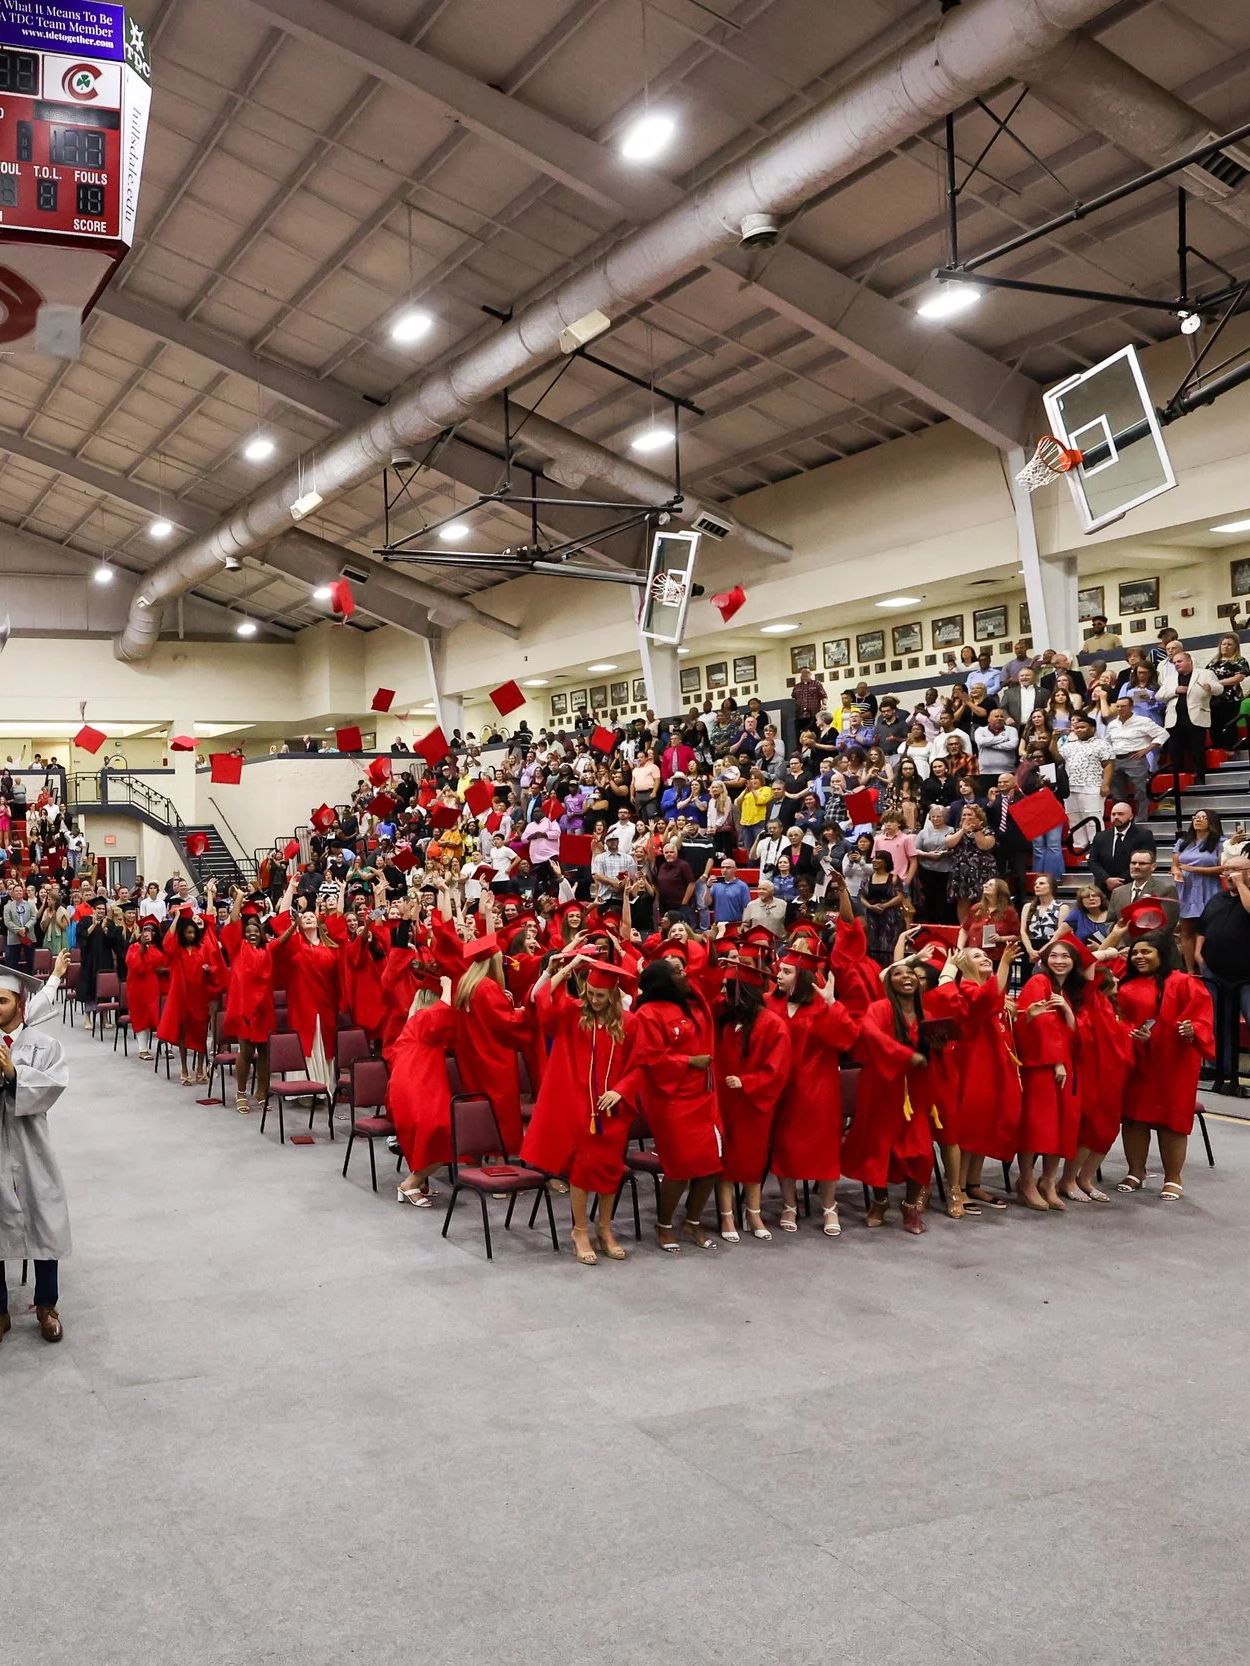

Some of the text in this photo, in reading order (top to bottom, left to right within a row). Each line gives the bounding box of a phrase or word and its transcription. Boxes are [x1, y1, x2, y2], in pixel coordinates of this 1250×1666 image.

[3, 0, 32, 13] What
[35, 4, 44, 14] It
[47, 5, 81, 20] Means
[83, 11, 97, 23] To
[99, 13, 113, 25] Be
[9, 12, 34, 26] TDC
[36, 16, 66, 31] Team
[69, 21, 114, 38] Member
[21, 28, 115, 49] www.tdctogether.com
[125, 42, 150, 78] TDC
[33, 165, 62, 180] T.O.L.
[125, 107, 141, 222] hillsdale.edu
[74, 170, 108, 185] FOULS
[73, 218, 107, 233] SCORE
